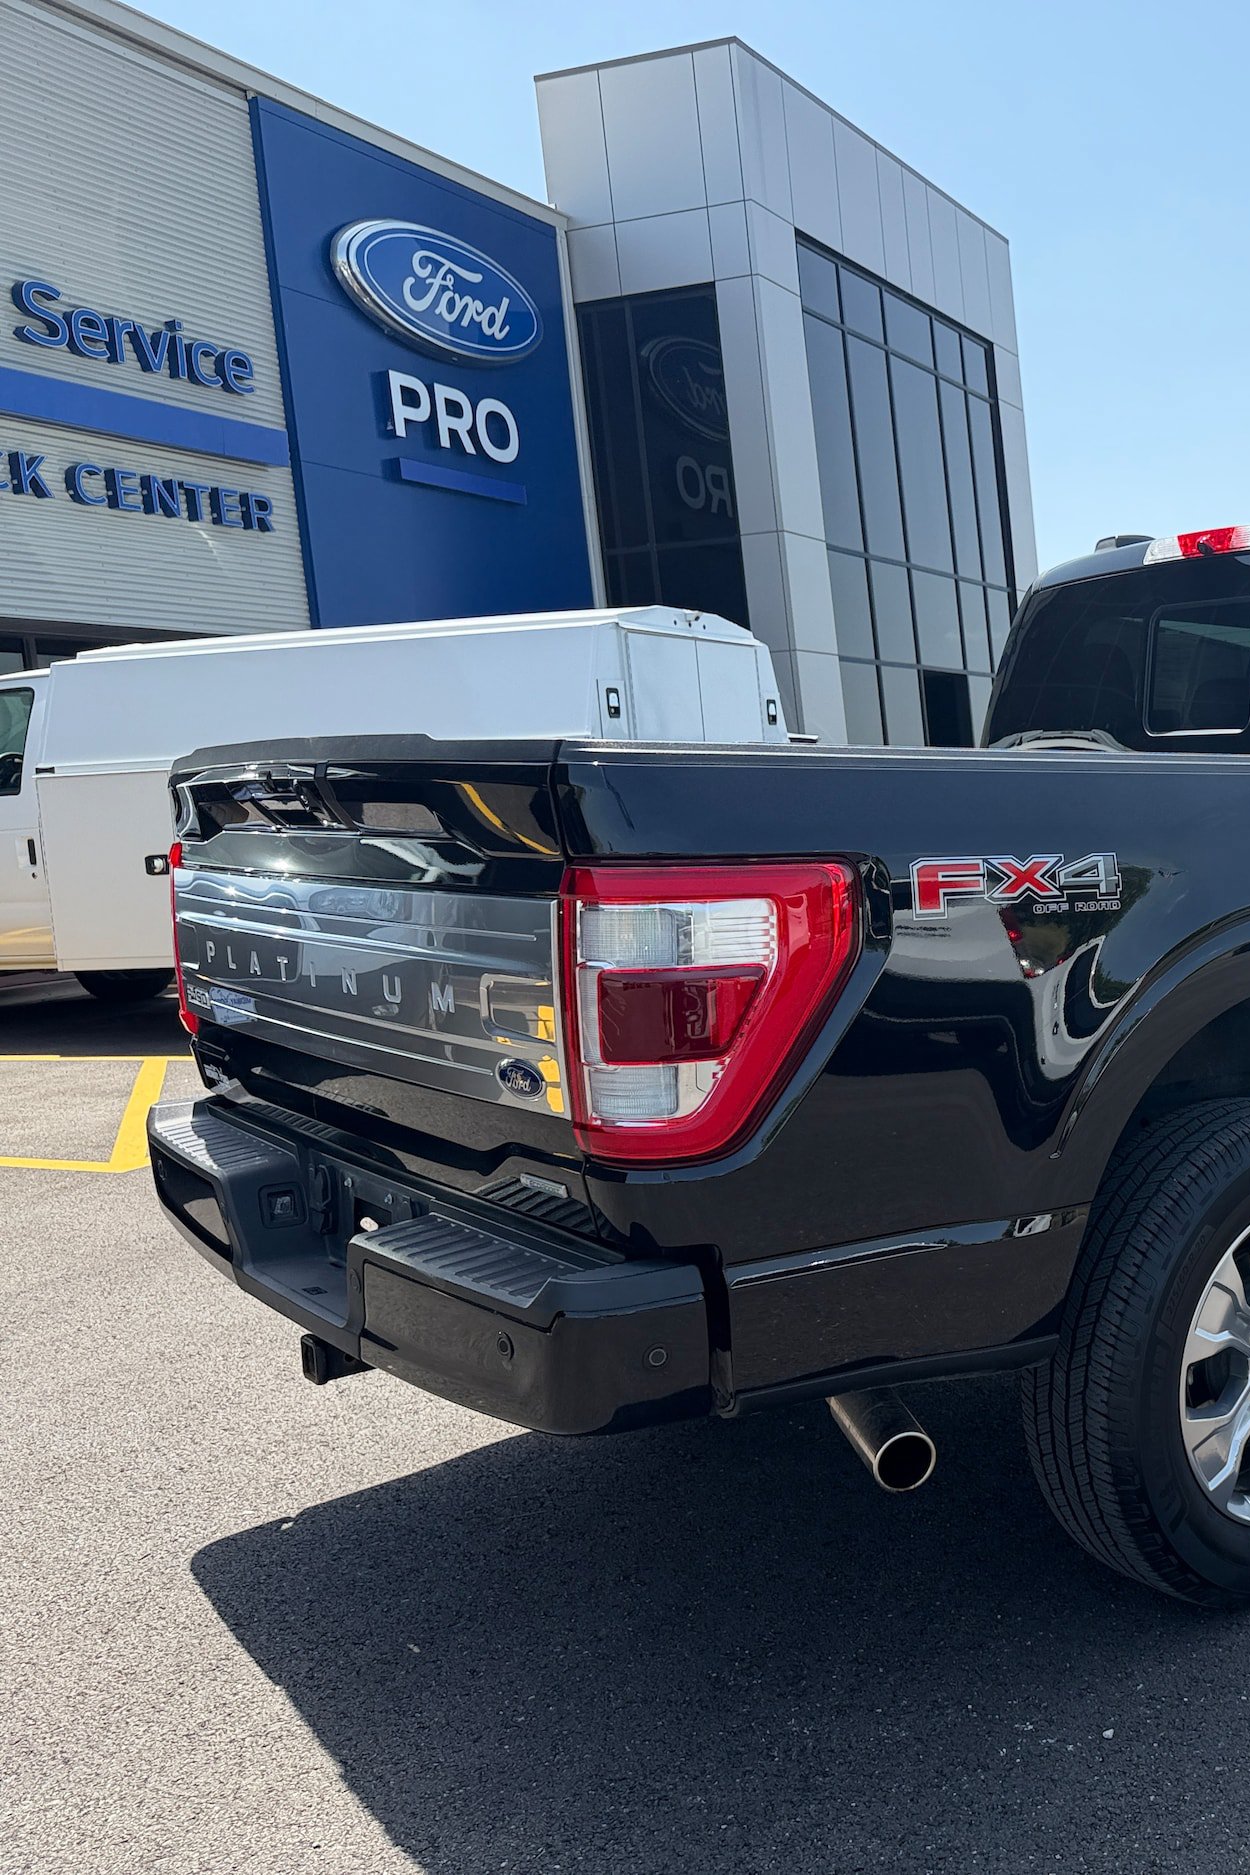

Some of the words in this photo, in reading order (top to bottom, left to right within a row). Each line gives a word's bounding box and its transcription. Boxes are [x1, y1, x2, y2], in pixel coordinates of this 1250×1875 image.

[403, 250, 511, 340] Ford
[13, 279, 255, 395] Service
[388, 368, 520, 464] PRO
[65, 463, 275, 532] CENTER
[909, 852, 1123, 921] FX4
[1033, 903, 1069, 914] OFF
[1075, 900, 1121, 913] ROAD
[206, 940, 456, 1014] PLATINUM
[505, 1066, 532, 1092] Ford
